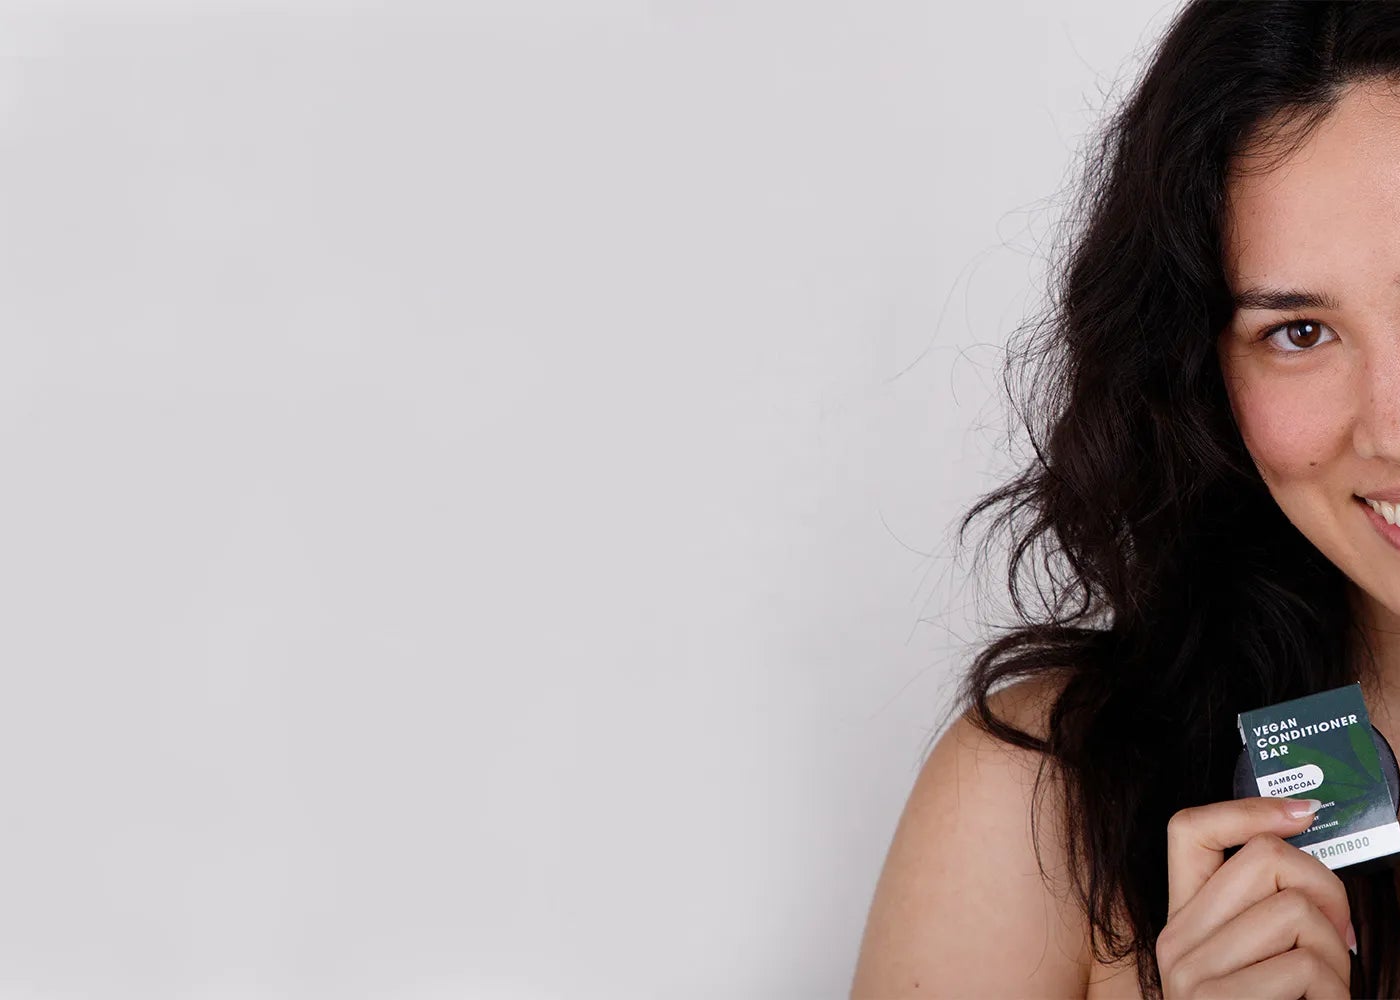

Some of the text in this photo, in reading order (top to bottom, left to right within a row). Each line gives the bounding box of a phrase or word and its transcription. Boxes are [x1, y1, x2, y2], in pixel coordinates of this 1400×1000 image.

[1253, 718, 1298, 736] VEGAN
[1257, 714, 1358, 748] CONDITIONER
[1259, 746, 1289, 761] BAR
[1268, 773, 1303, 787] BAMBOO
[1271, 780, 1316, 796] CHARCOAL
